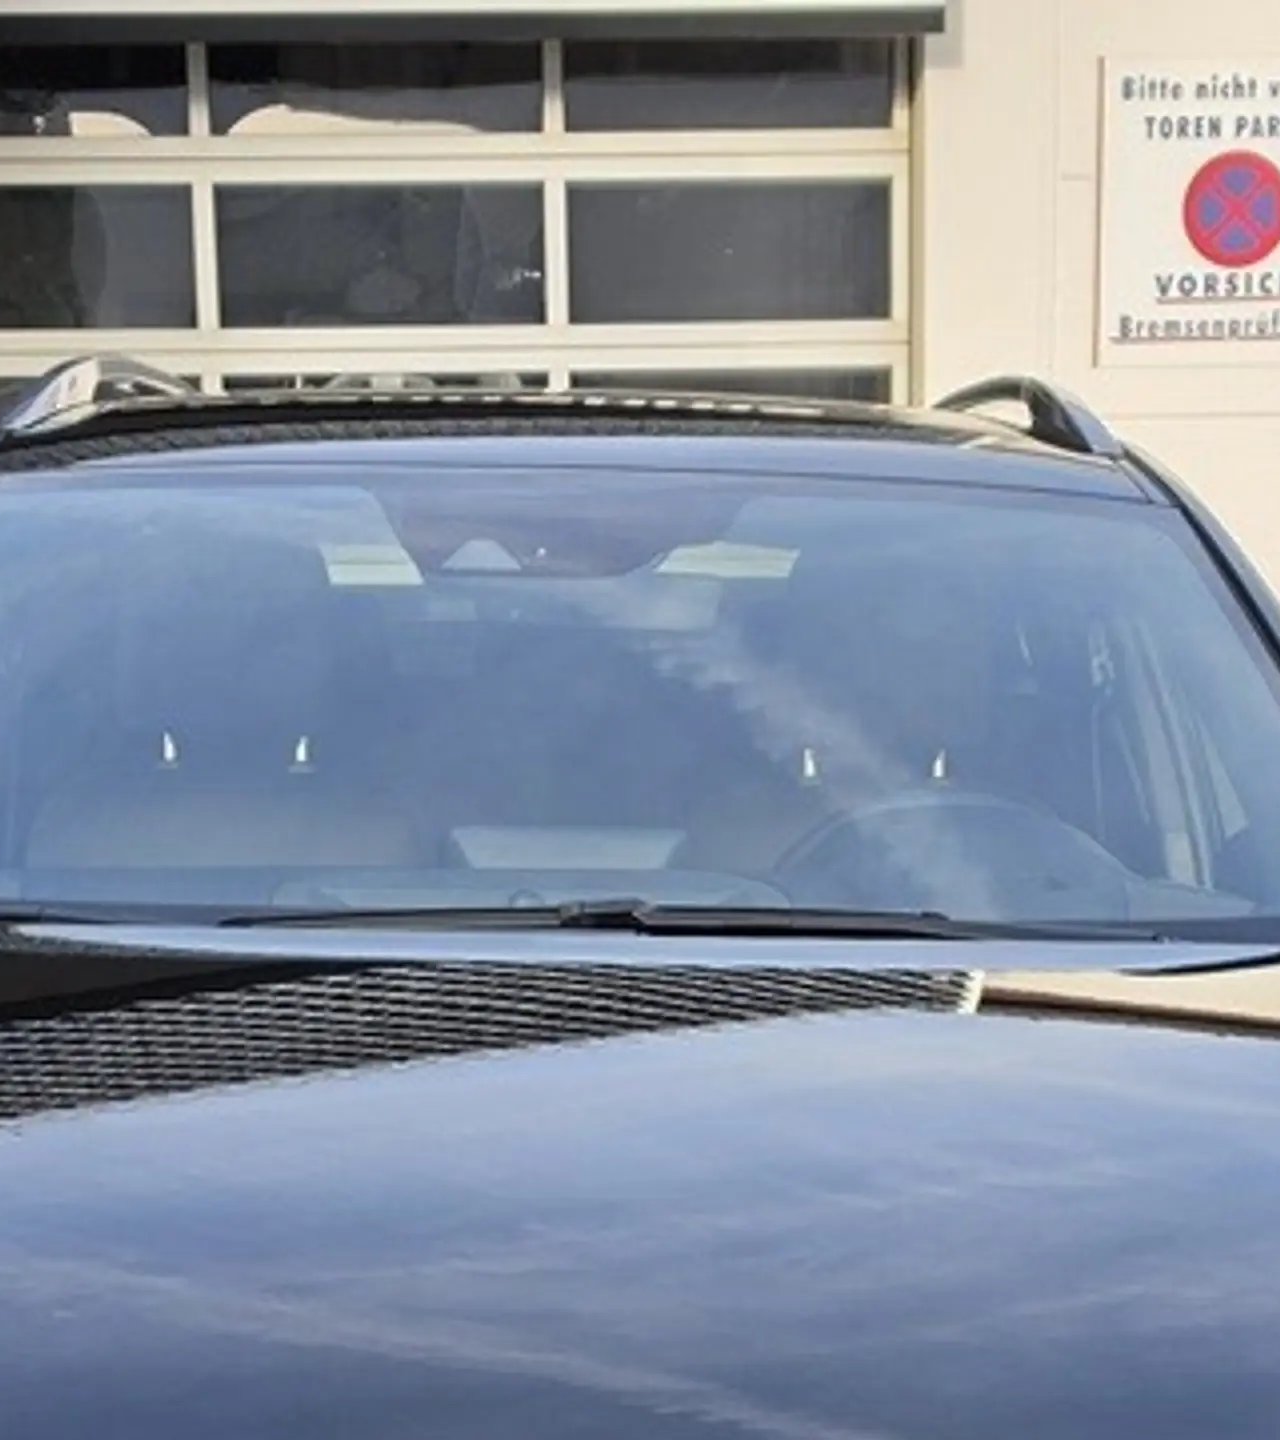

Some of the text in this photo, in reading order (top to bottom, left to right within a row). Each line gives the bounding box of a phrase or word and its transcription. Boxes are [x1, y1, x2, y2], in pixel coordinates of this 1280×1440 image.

[1121, 75, 1184, 101] Bitte
[1194, 73, 1258, 99] nicht
[1144, 115, 1221, 139] TOREN
